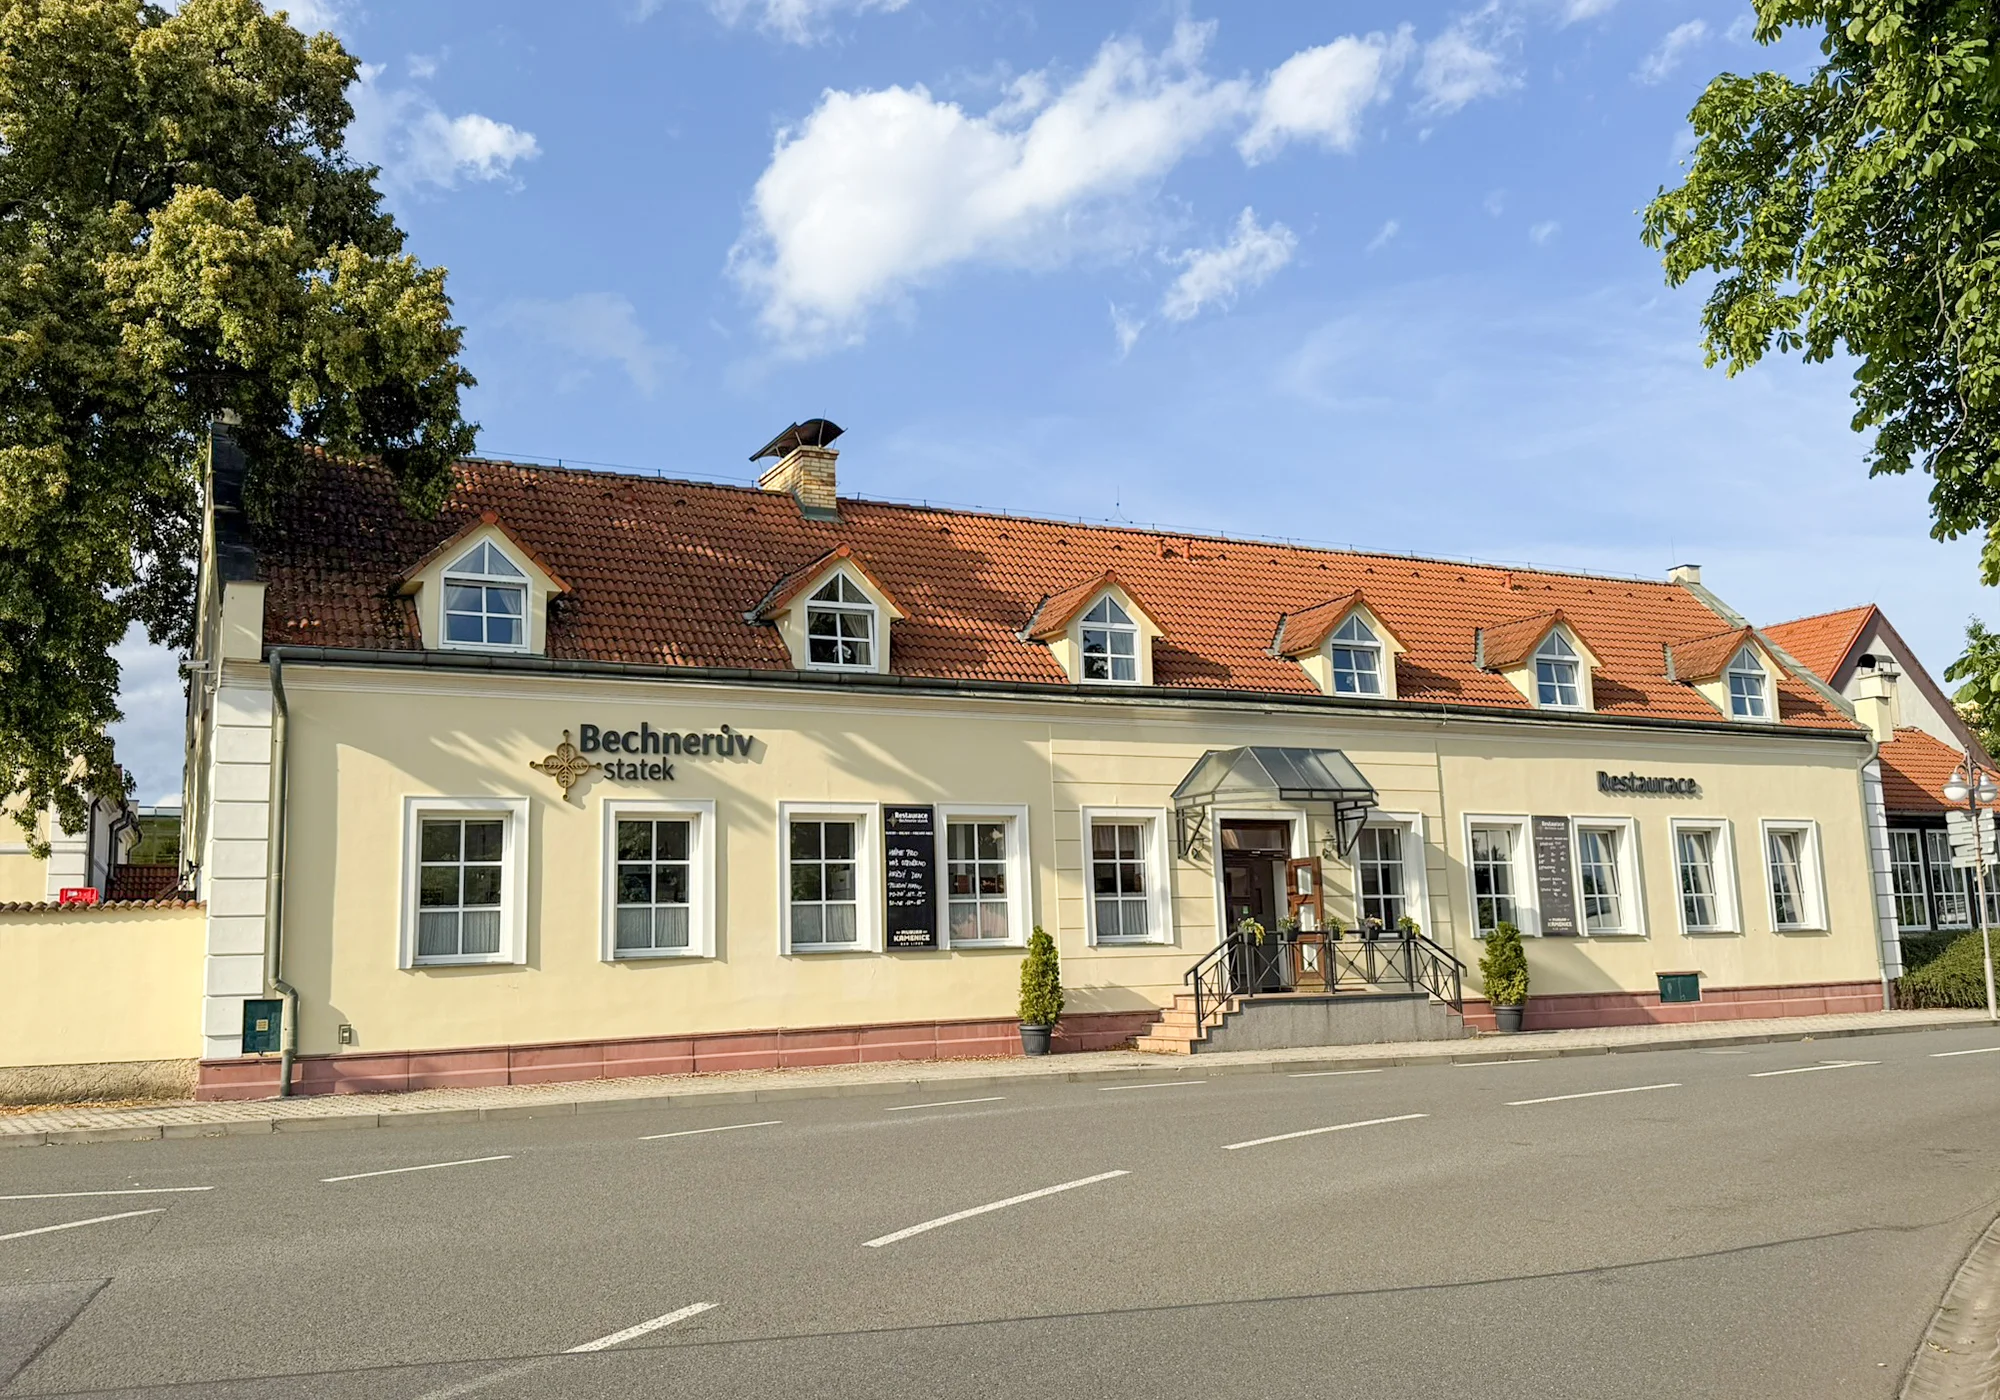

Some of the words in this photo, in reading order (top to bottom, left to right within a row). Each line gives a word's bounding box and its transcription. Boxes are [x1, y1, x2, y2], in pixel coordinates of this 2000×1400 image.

[580, 722, 753, 756] Bechnerův
[604, 757, 675, 781] statek
[1596, 771, 1697, 794] Restaurace
[893, 934, 931, 942] KAMENICE
